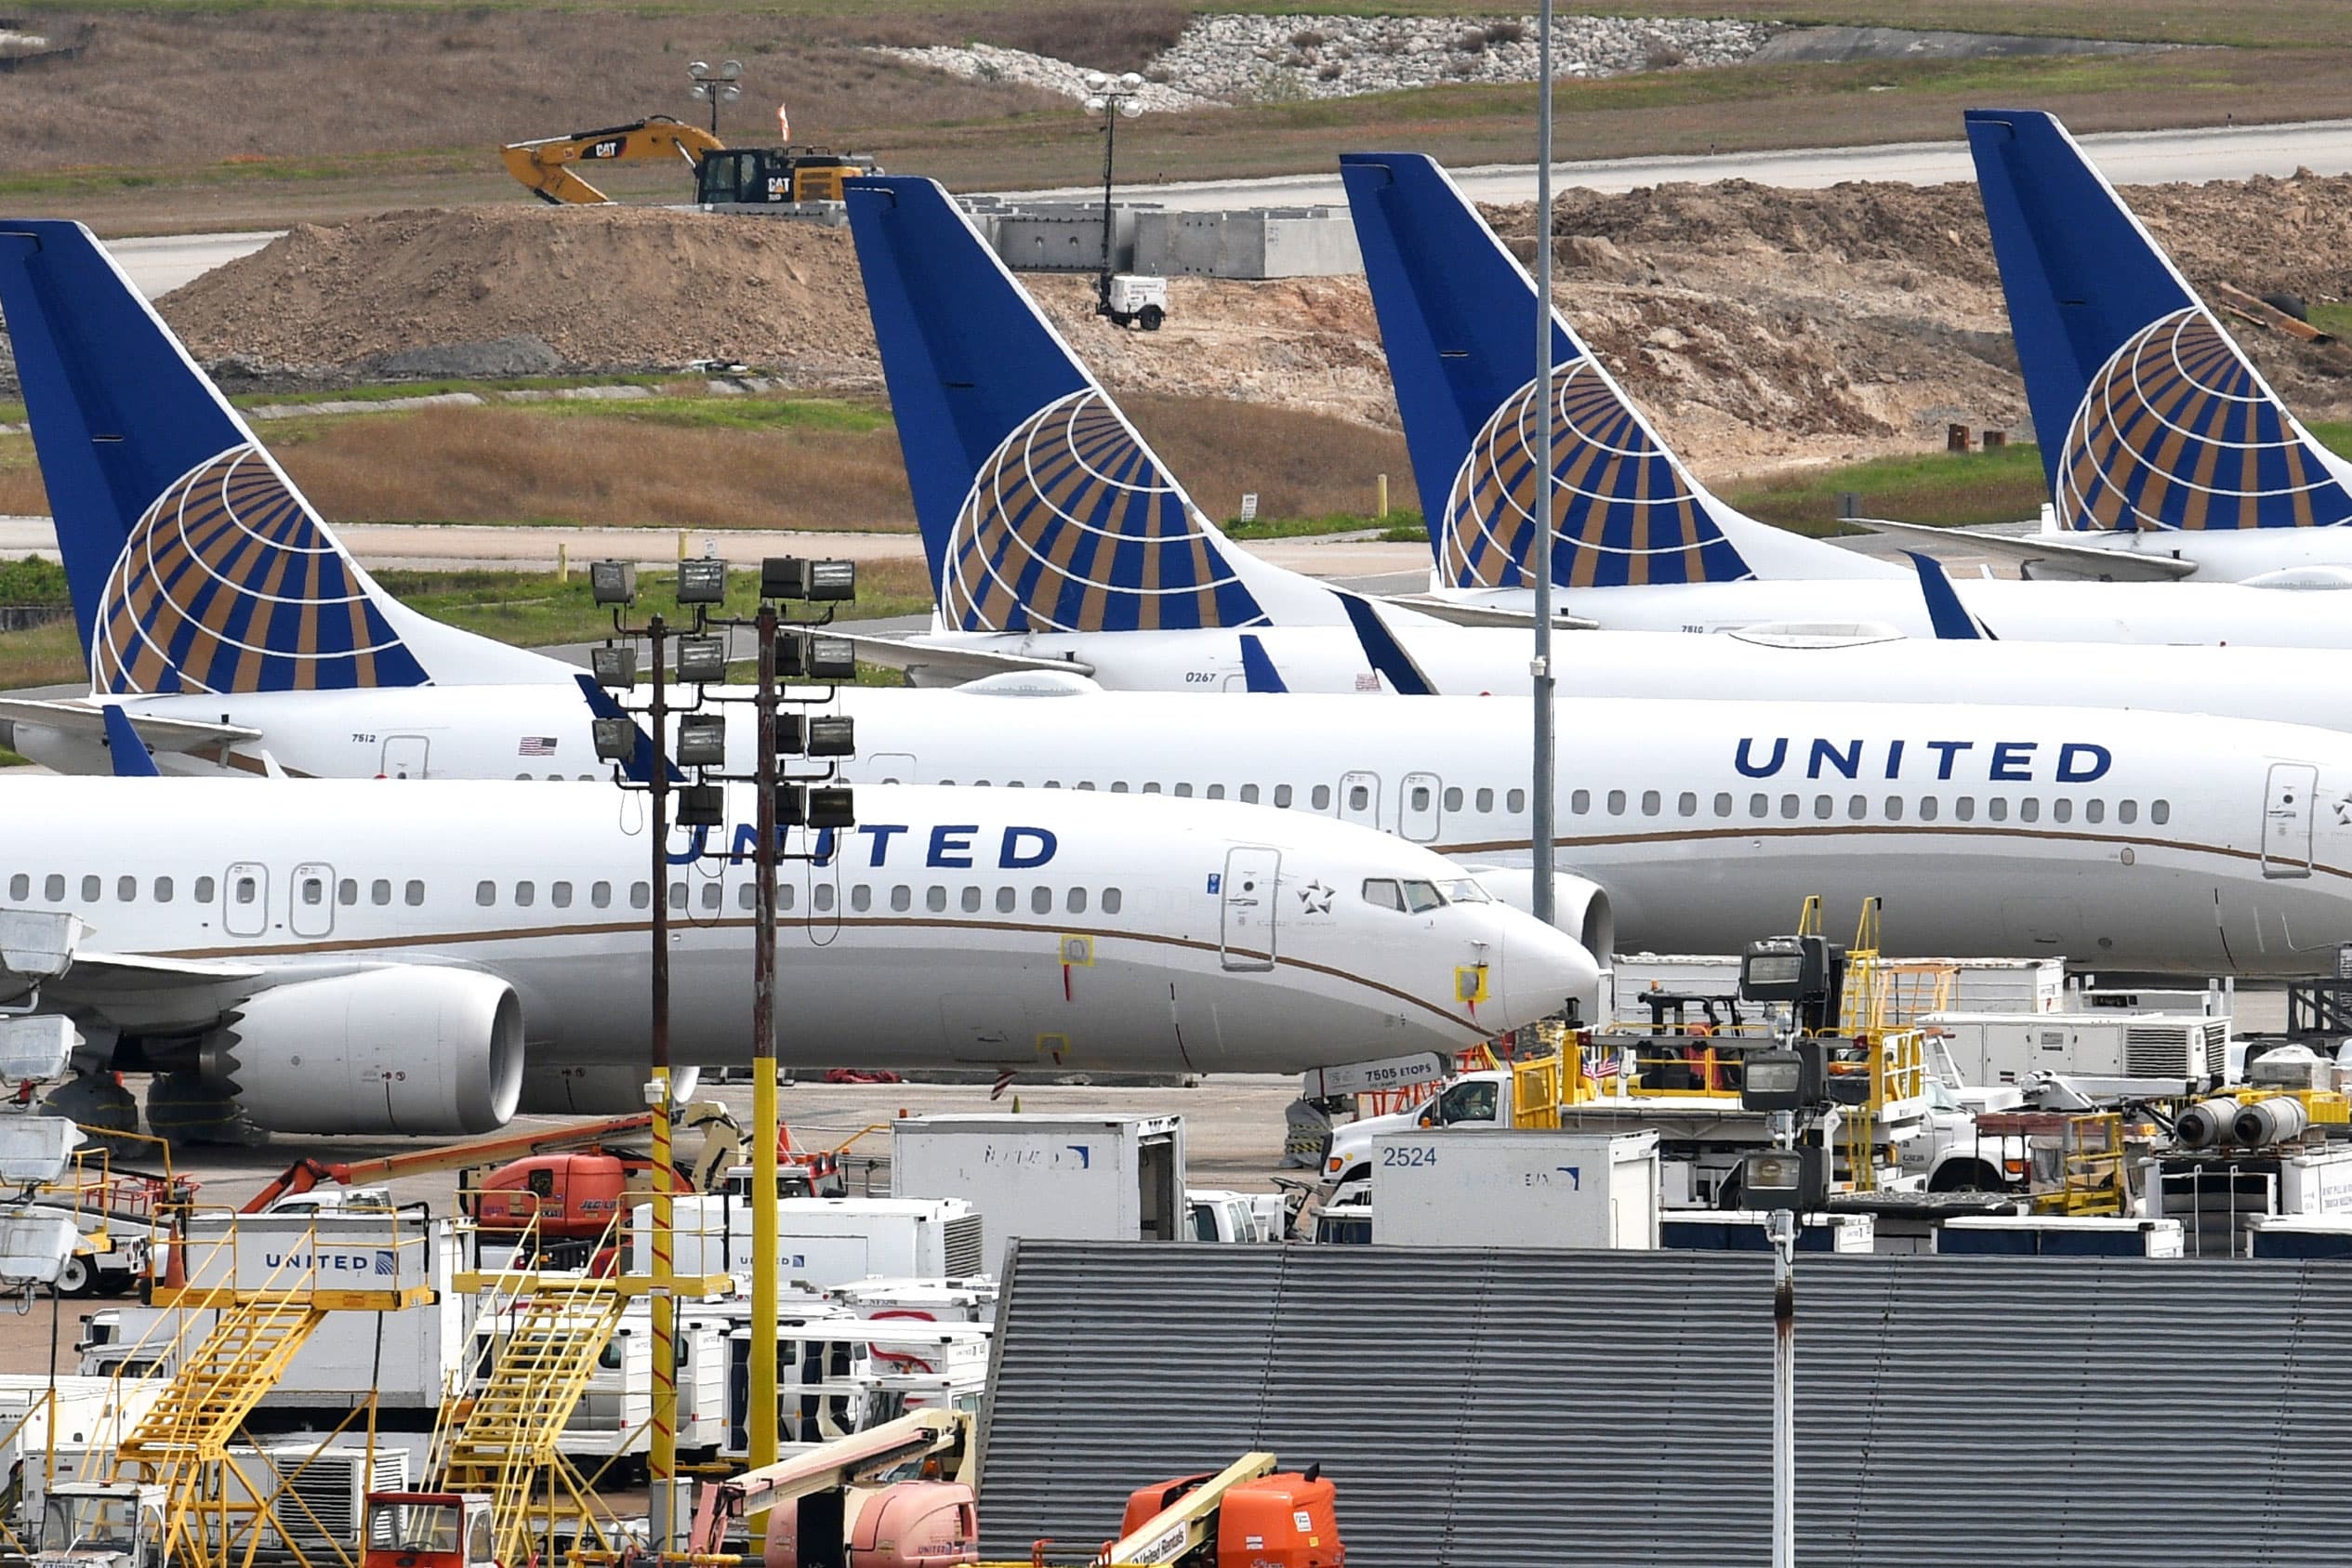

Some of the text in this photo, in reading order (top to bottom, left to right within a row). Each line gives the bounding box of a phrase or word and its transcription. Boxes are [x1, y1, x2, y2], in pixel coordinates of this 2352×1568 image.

[596, 142, 616, 157] CAT
[768, 177, 789, 192] CAT
[1186, 672, 1216, 682] 0267
[352, 733, 376, 743] 7512
[1734, 738, 2112, 783] UNITED
[1365, 1068, 1397, 1082] 7505
[1400, 1063, 1432, 1076] ETOPS
[1383, 1147, 1437, 1166] 2524
[266, 1254, 368, 1270] UNITED
